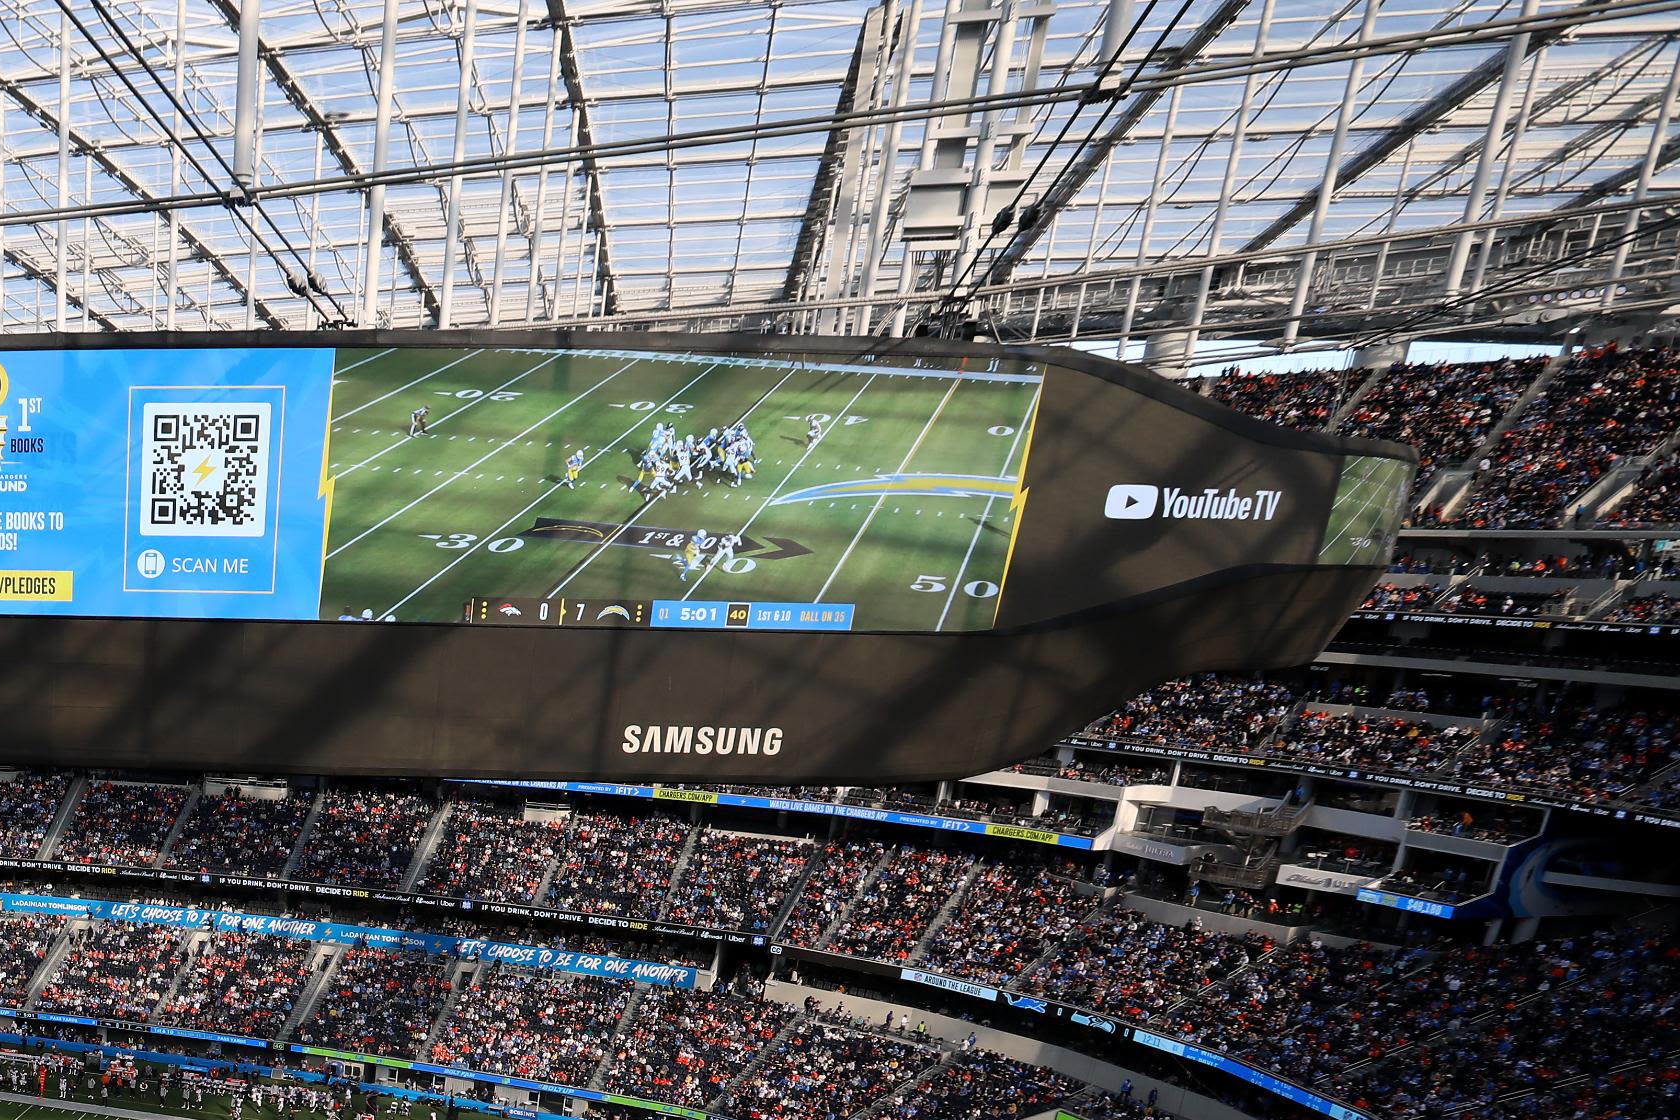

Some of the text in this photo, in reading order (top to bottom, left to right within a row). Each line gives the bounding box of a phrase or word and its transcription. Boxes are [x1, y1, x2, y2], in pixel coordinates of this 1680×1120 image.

[17, 397, 42, 432] 1ST
[10, 438, 44, 453] BOOKS
[1161, 487, 1281, 521] YouTube TV
[5, 511, 45, 530] BOOKS
[48, 511, 64, 530] TO
[435, 533, 526, 553] 30
[172, 557, 249, 573] SCAN ME
[910, 574, 1000, 598] 50
[539, 602, 549, 622] 0
[576, 603, 585, 622] 7
[680, 608, 717, 621] 5:01
[730, 609, 746, 620] 40
[800, 611, 819, 622] BALL
[821, 611, 832, 622] ON
[834, 611, 845, 622] 35
[622, 724, 783, 756] SAMSUNG
[659, 790, 713, 802] CHARGERS.COM/APP
[769, 800, 789, 810] WATCH
[790, 802, 803, 812] LIVE
[834, 805, 845, 816] THE
[992, 826, 1053, 842] CHARGERS.COM/APP
[111, 903, 138, 918] LET'S
[141, 905, 182, 922] CHOOSE
[186, 909, 198, 922] TO
[219, 914, 241, 928] FOR
[268, 919, 316, 936] ANOTHER
[490, 905, 505, 913] YOU
[507, 907, 532, 917] DRINK,
[534, 910, 557, 919] DON'T
[559, 912, 584, 922] DRIVE.
[588, 915, 616, 926] DECIDE
[617, 919, 629, 927] TO
[629, 920, 648, 930] RIDE
[488, 943, 536, 961] CHOOSE
[538, 950, 553, 963] TO
[554, 952, 572, 966] BE
[576, 955, 601, 970] FOR
[604, 958, 630, 973] ONE
[924, 975, 948, 987] AROUND
[949, 980, 959, 989] THE
